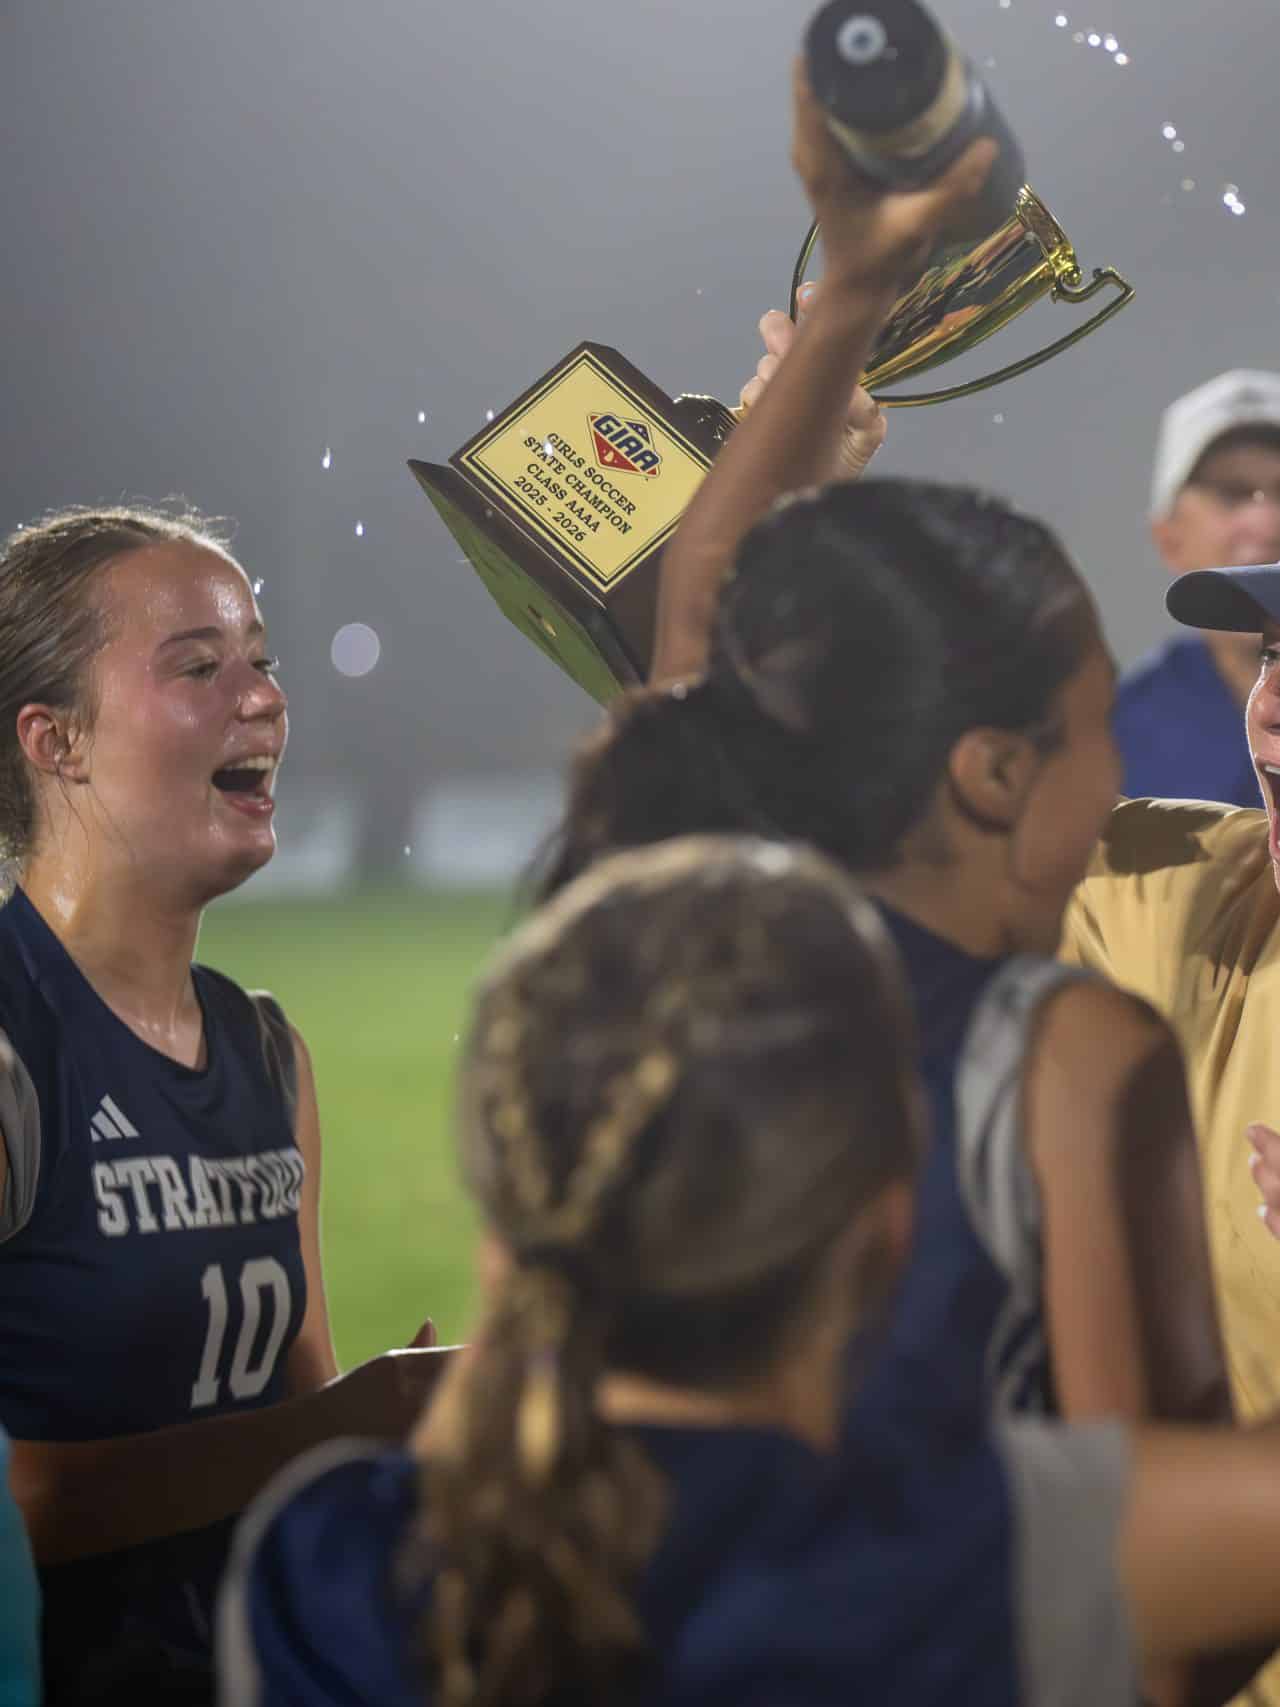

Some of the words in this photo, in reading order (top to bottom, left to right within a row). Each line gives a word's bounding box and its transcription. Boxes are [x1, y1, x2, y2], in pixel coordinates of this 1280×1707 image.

[546, 432, 586, 469] GIRLS
[583, 466, 637, 516] SOCCER
[593, 414, 660, 472] GIAA
[514, 475, 548, 506] 2025
[552, 511, 587, 542] 2026
[523, 436, 566, 475] STATE
[565, 473, 632, 535] CHAMPION
[527, 463, 568, 500] CLASS
[565, 500, 601, 533] AAAA
[190, 1256, 292, 1409] 10
